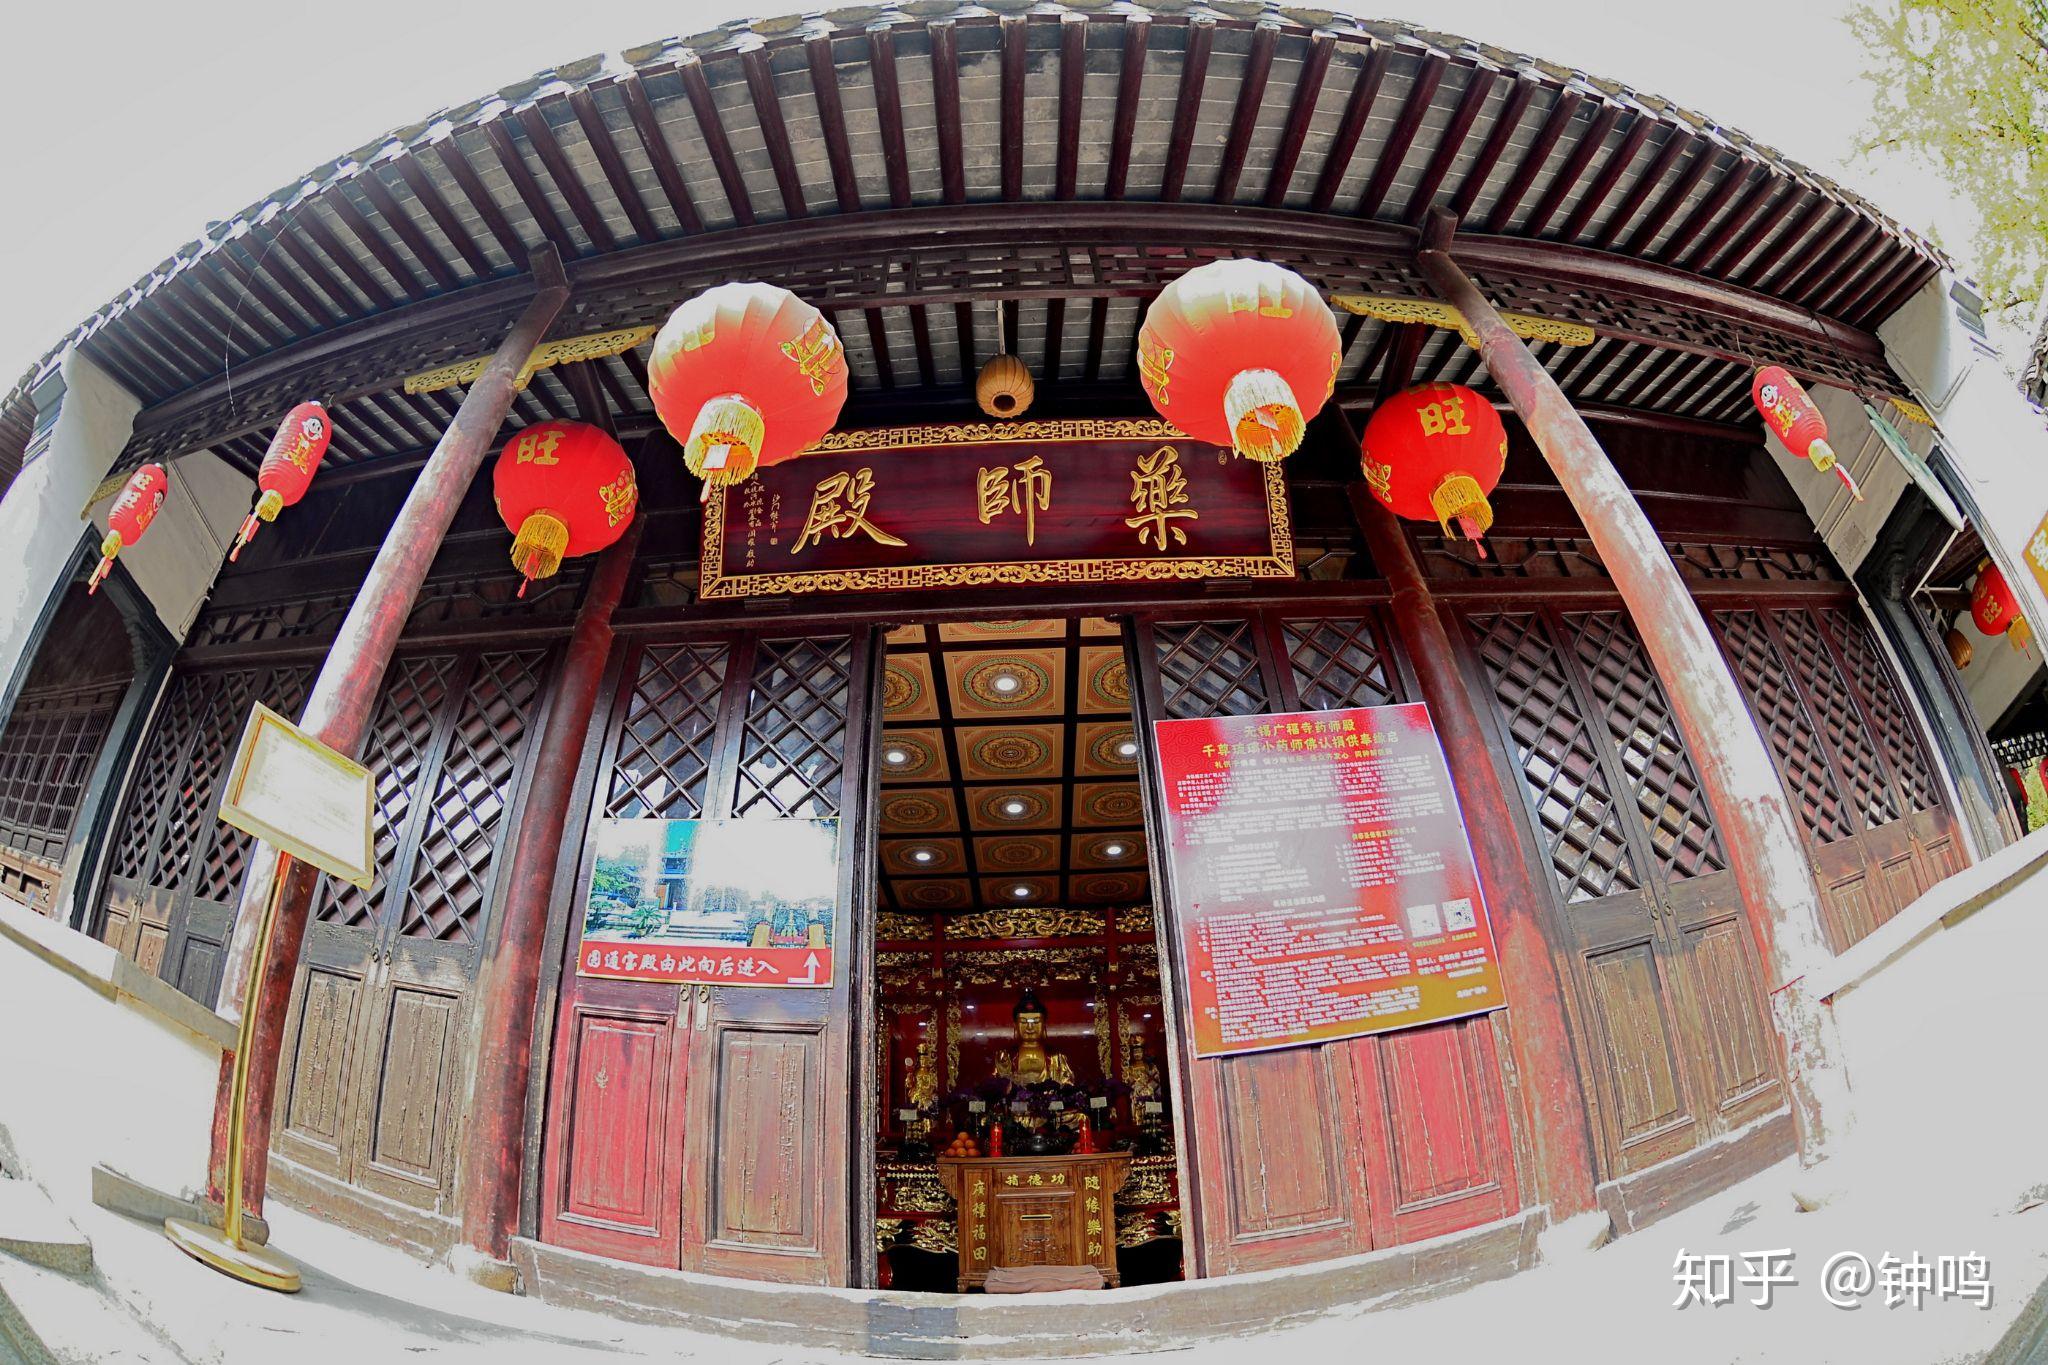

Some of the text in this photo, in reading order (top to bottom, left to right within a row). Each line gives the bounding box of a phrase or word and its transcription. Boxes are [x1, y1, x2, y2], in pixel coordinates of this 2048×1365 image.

[516, 430, 566, 466] 旺
[1244, 718, 1356, 738] 无锡广福寺药师殿
[586, 950, 779, 977] 圆通宝殿由此向后进入
[972, 1180, 987, 1261] 廣種福田
